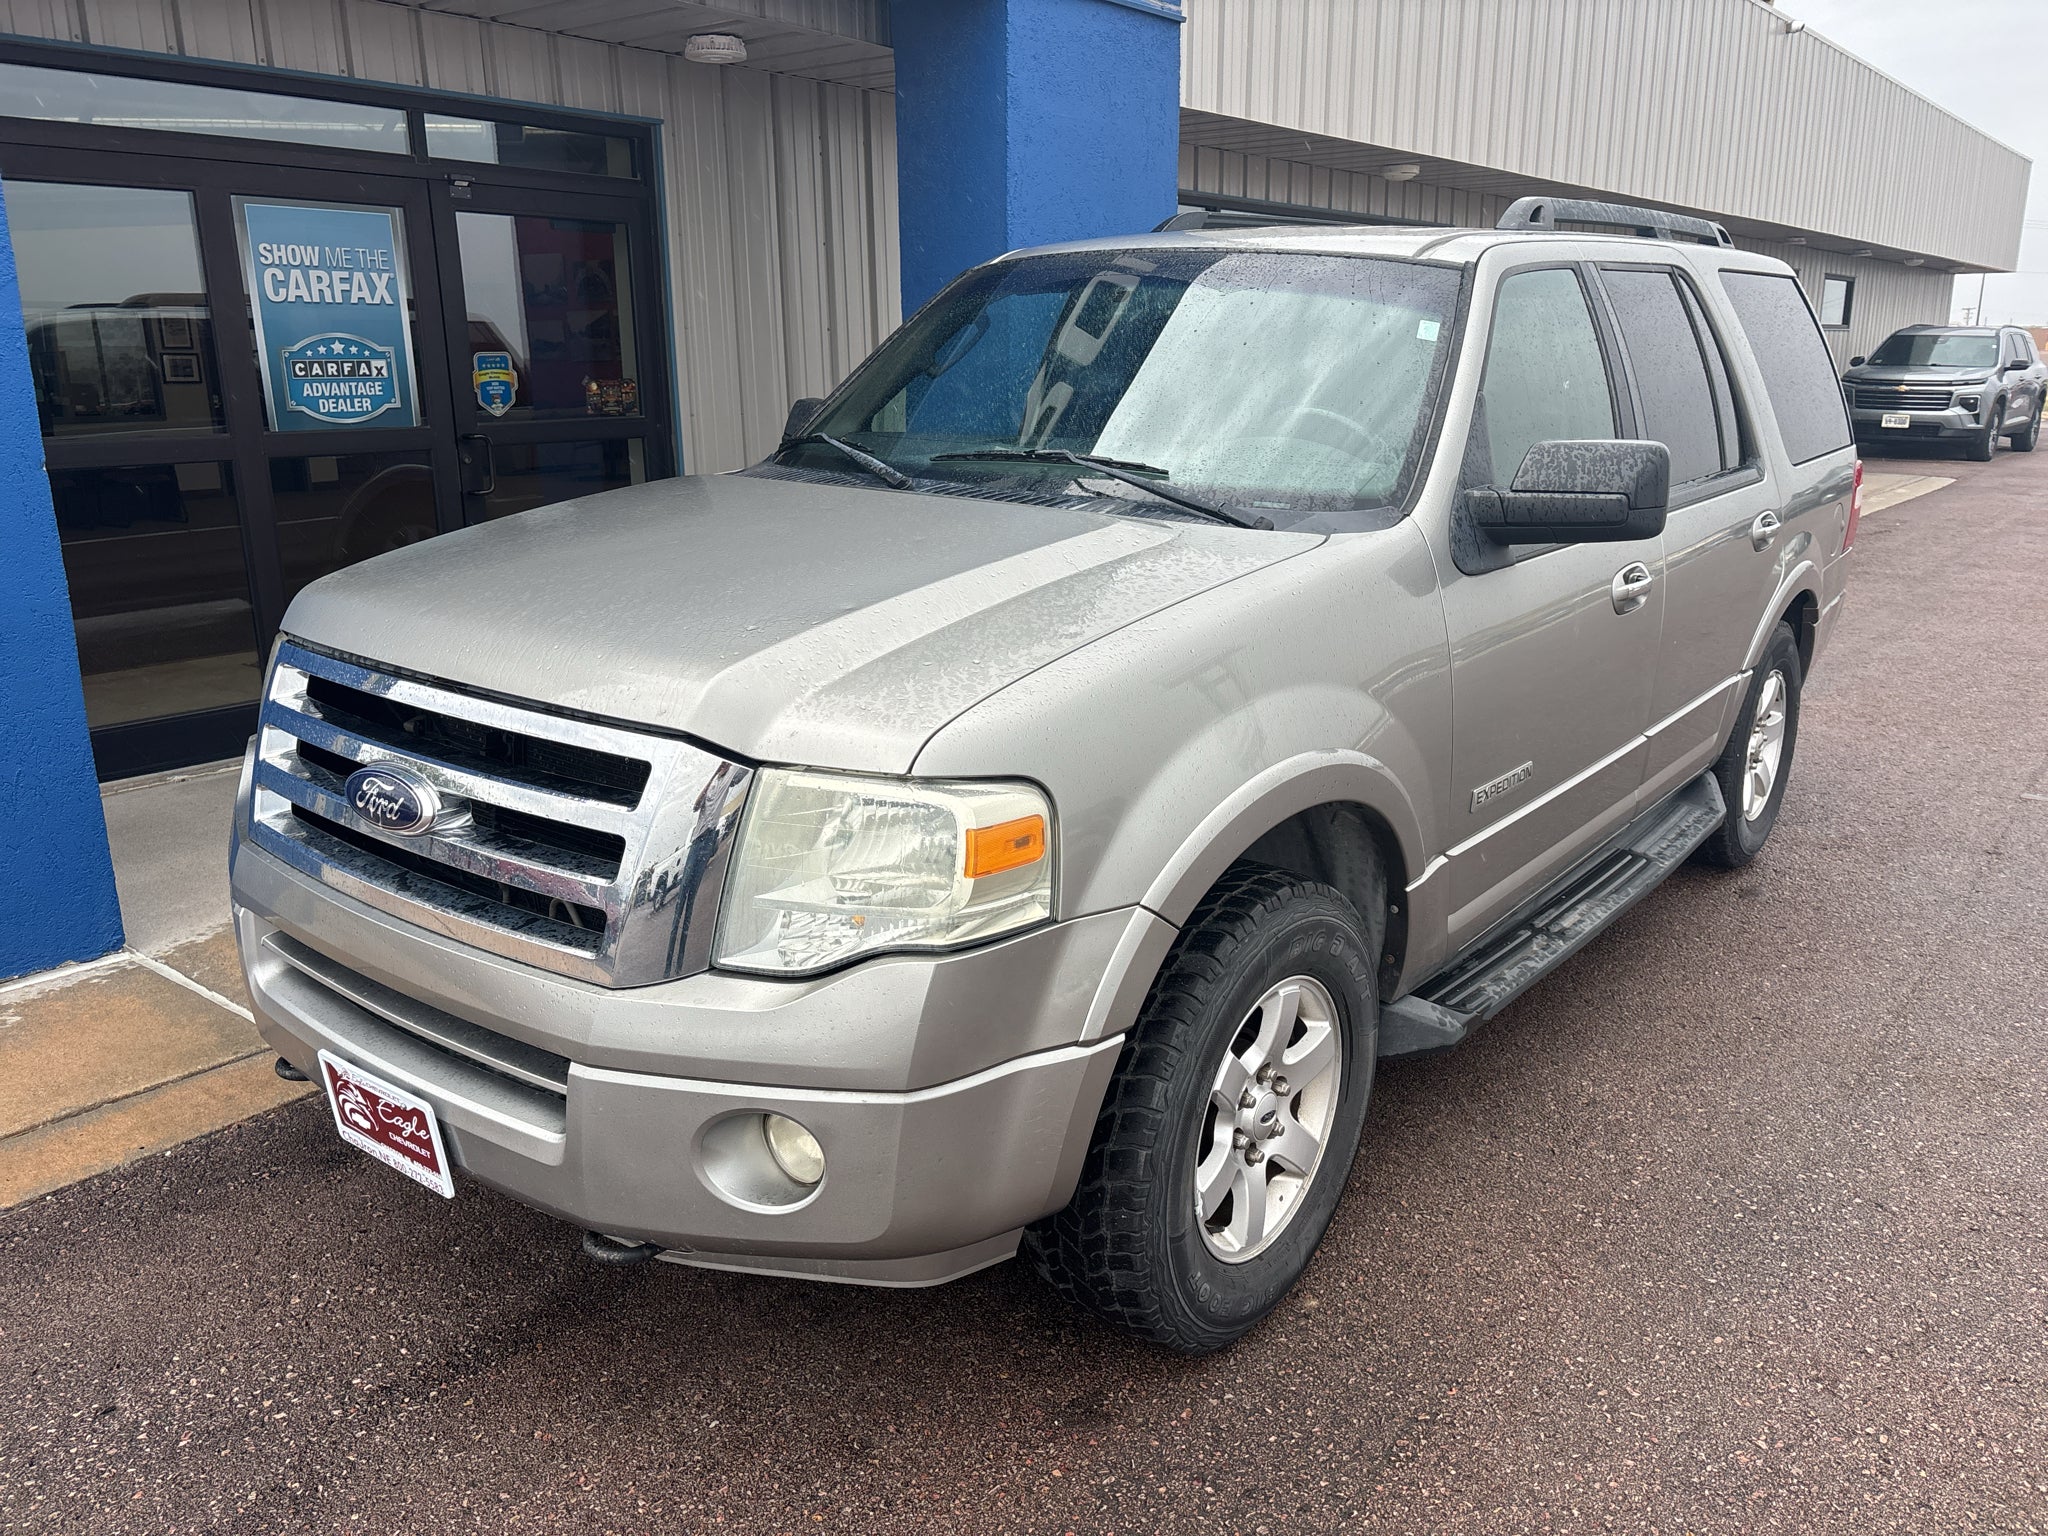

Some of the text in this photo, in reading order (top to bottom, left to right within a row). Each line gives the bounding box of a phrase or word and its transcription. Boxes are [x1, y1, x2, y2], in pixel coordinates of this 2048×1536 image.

[258, 242, 390, 270] SHOW ME THE
[263, 267, 394, 305] CARFAX
[294, 361, 387, 378] CARFAX
[303, 381, 384, 397] ADVANTAGE
[318, 398, 372, 413] DEALER
[356, 777, 405, 820] Ford
[1476, 765, 1532, 804] EXPEDITION
[1288, 929, 1326, 960] BIG
[376, 1098, 430, 1140] Eagle
[388, 1132, 431, 1159] CHEVROLET
